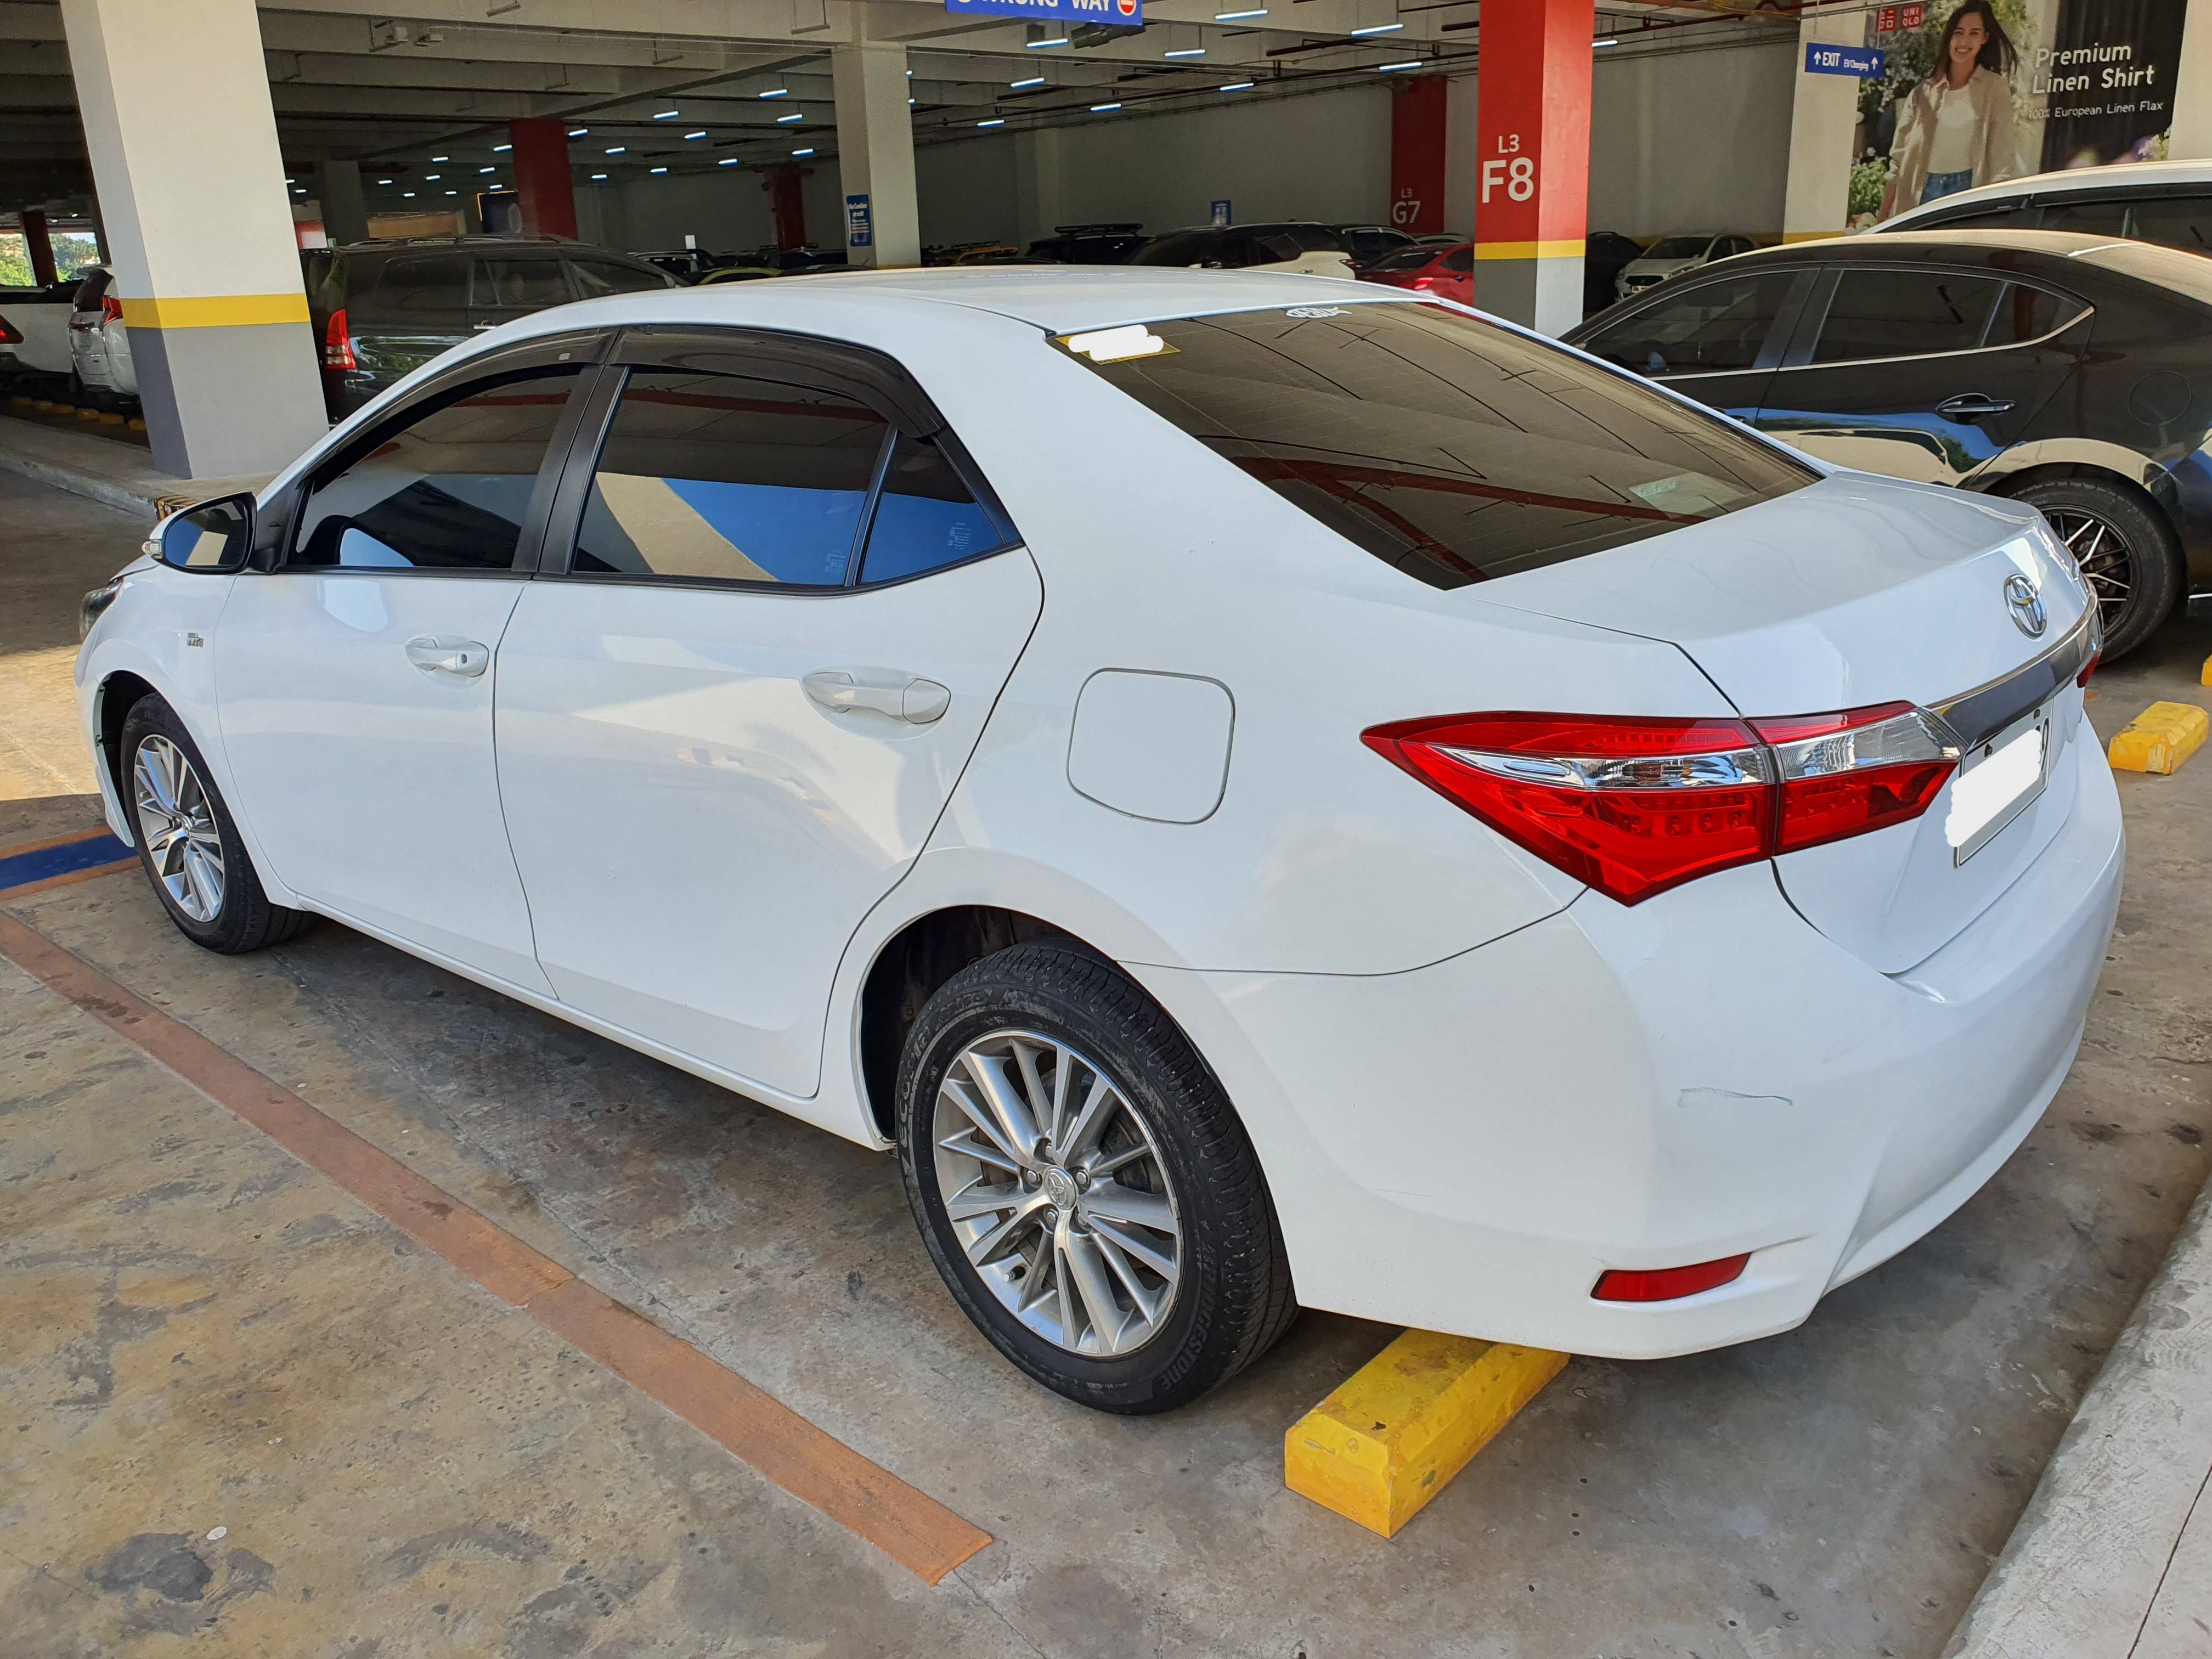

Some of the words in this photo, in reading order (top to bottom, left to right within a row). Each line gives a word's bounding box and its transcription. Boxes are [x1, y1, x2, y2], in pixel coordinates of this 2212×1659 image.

[1902, 16, 1920, 26] QLO
[1903, 7, 1920, 16] UNI
[1822, 52, 1841, 67] EXIT
[2035, 42, 2131, 68] Premium
[2033, 74, 2090, 94] Linen
[2101, 65, 2155, 88] Shirt
[2055, 106, 2102, 118] European
[2106, 103, 2135, 114] Linen
[2140, 100, 2164, 111] Flax
[1498, 134, 1520, 154] L3
[1482, 157, 1534, 204] F8
[1401, 188, 1413, 198] L3
[1392, 201, 1421, 224] G7
